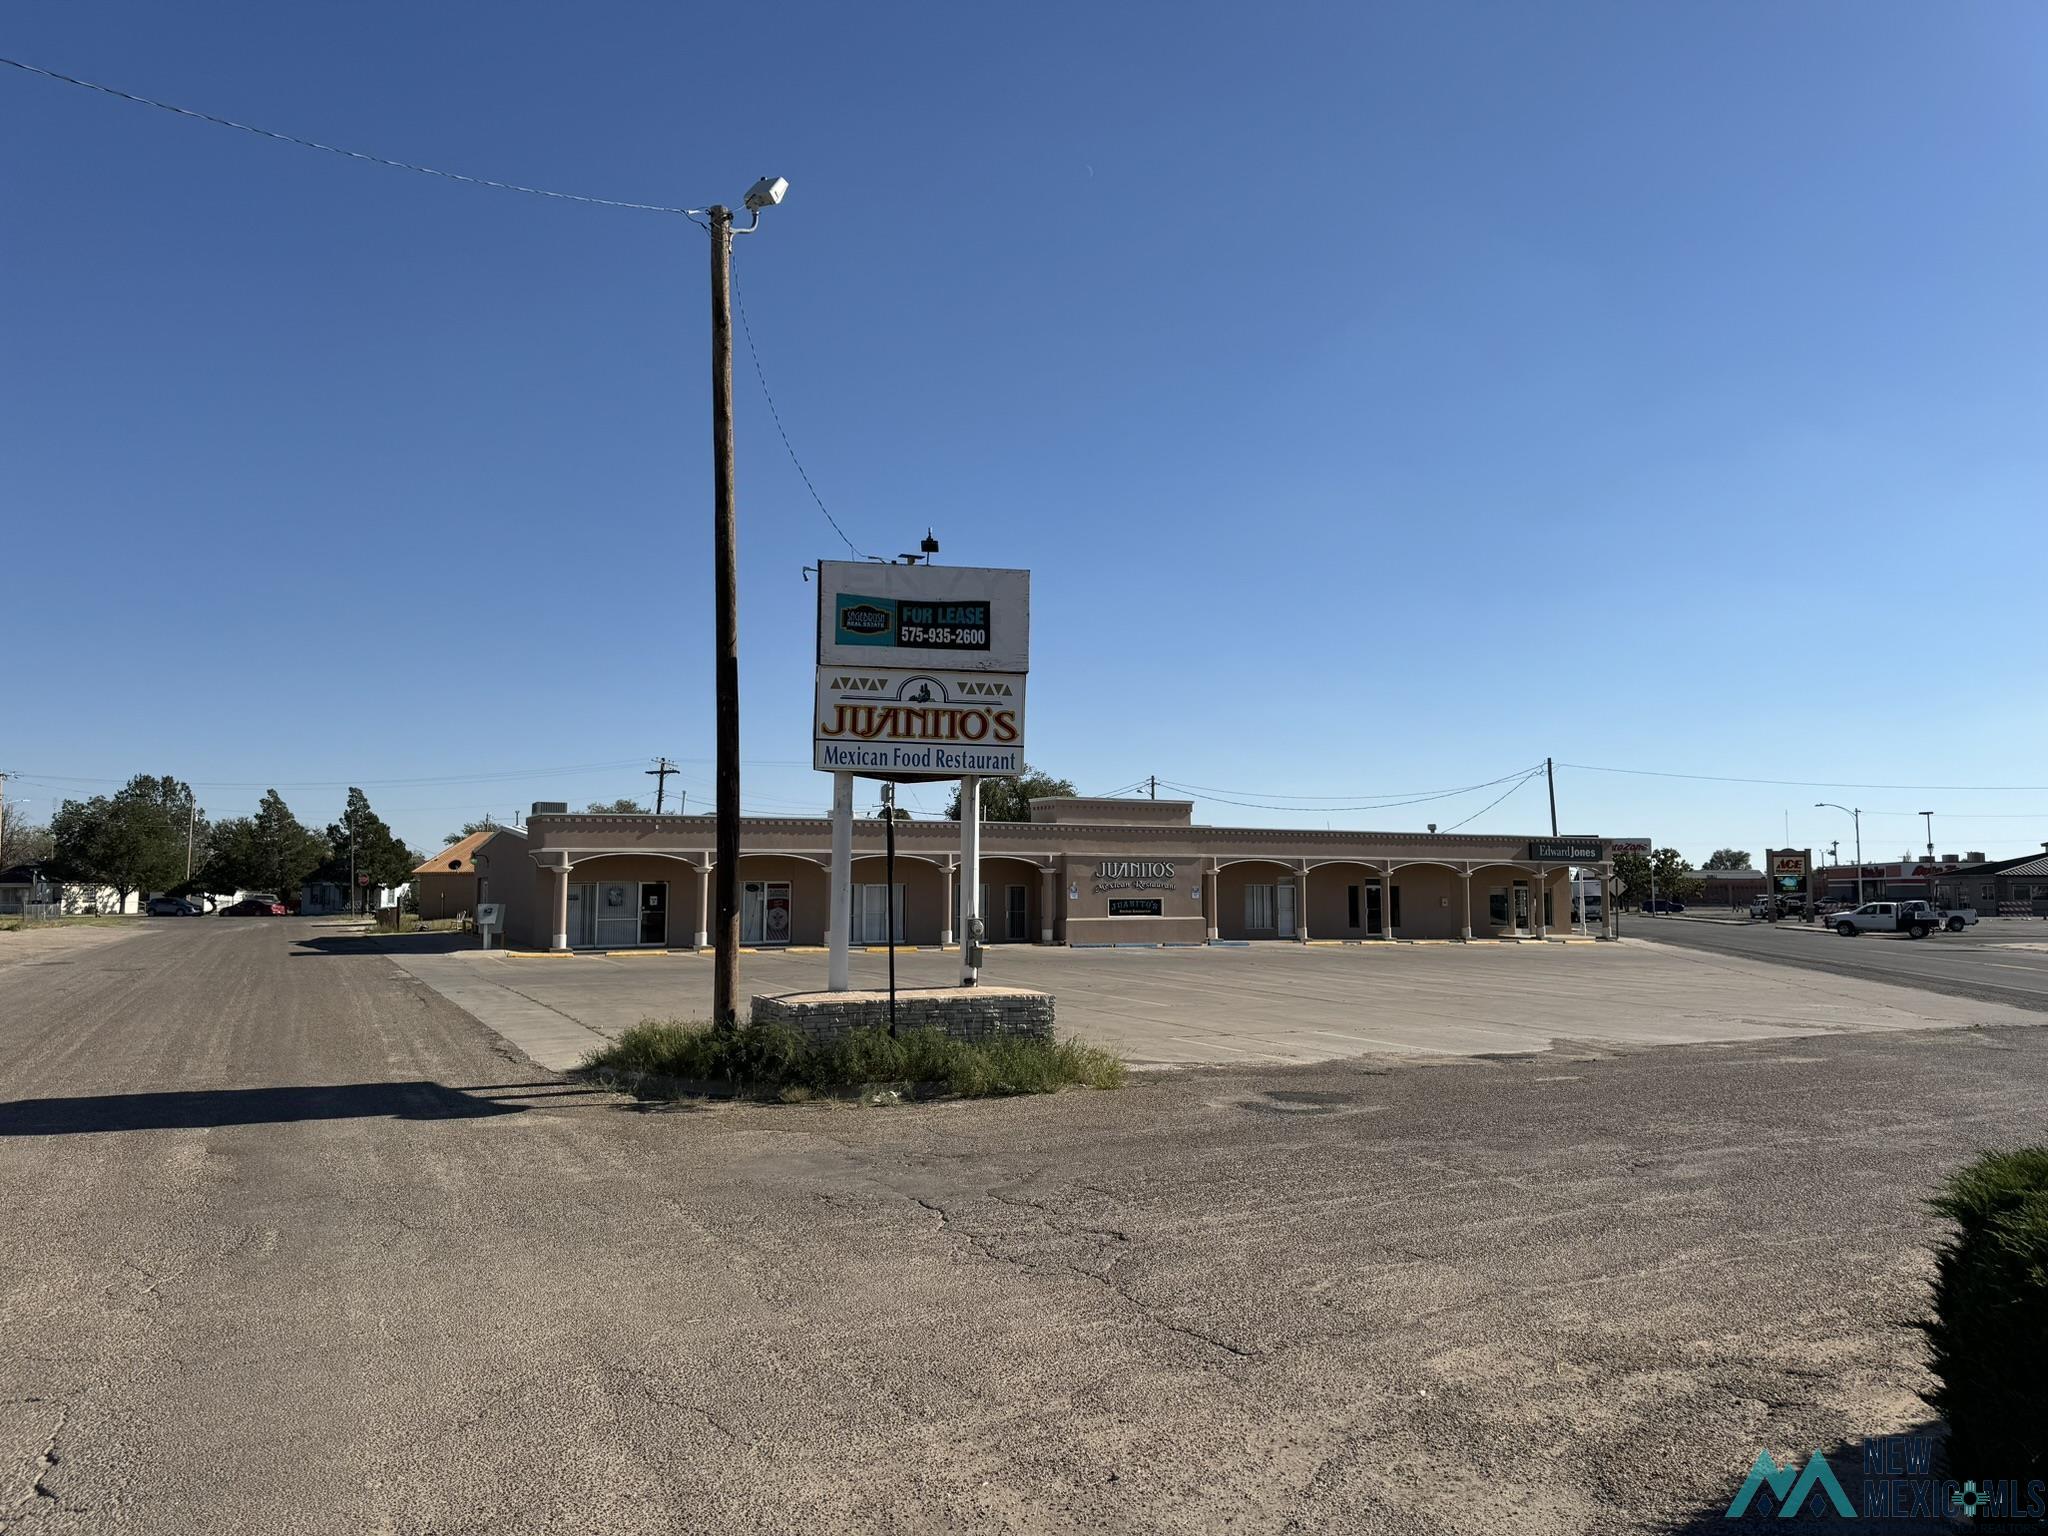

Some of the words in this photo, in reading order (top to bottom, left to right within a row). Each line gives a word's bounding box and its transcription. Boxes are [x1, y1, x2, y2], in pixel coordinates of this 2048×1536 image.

[903, 607, 933, 624] FOR
[938, 607, 984, 626] LEASE
[901, 626, 986, 645] 575-935-2600
[821, 703, 1019, 743] JUANITO'S
[824, 745, 888, 766] Mexican
[893, 748, 931, 768] Food
[935, 749, 1016, 770] Restaurant
[1096, 862, 1175, 879] JUANITO'S
[1776, 859, 1803, 869] ACE
[1095, 882, 1130, 893] Mexican
[1133, 880, 1176, 891] Restaurant
